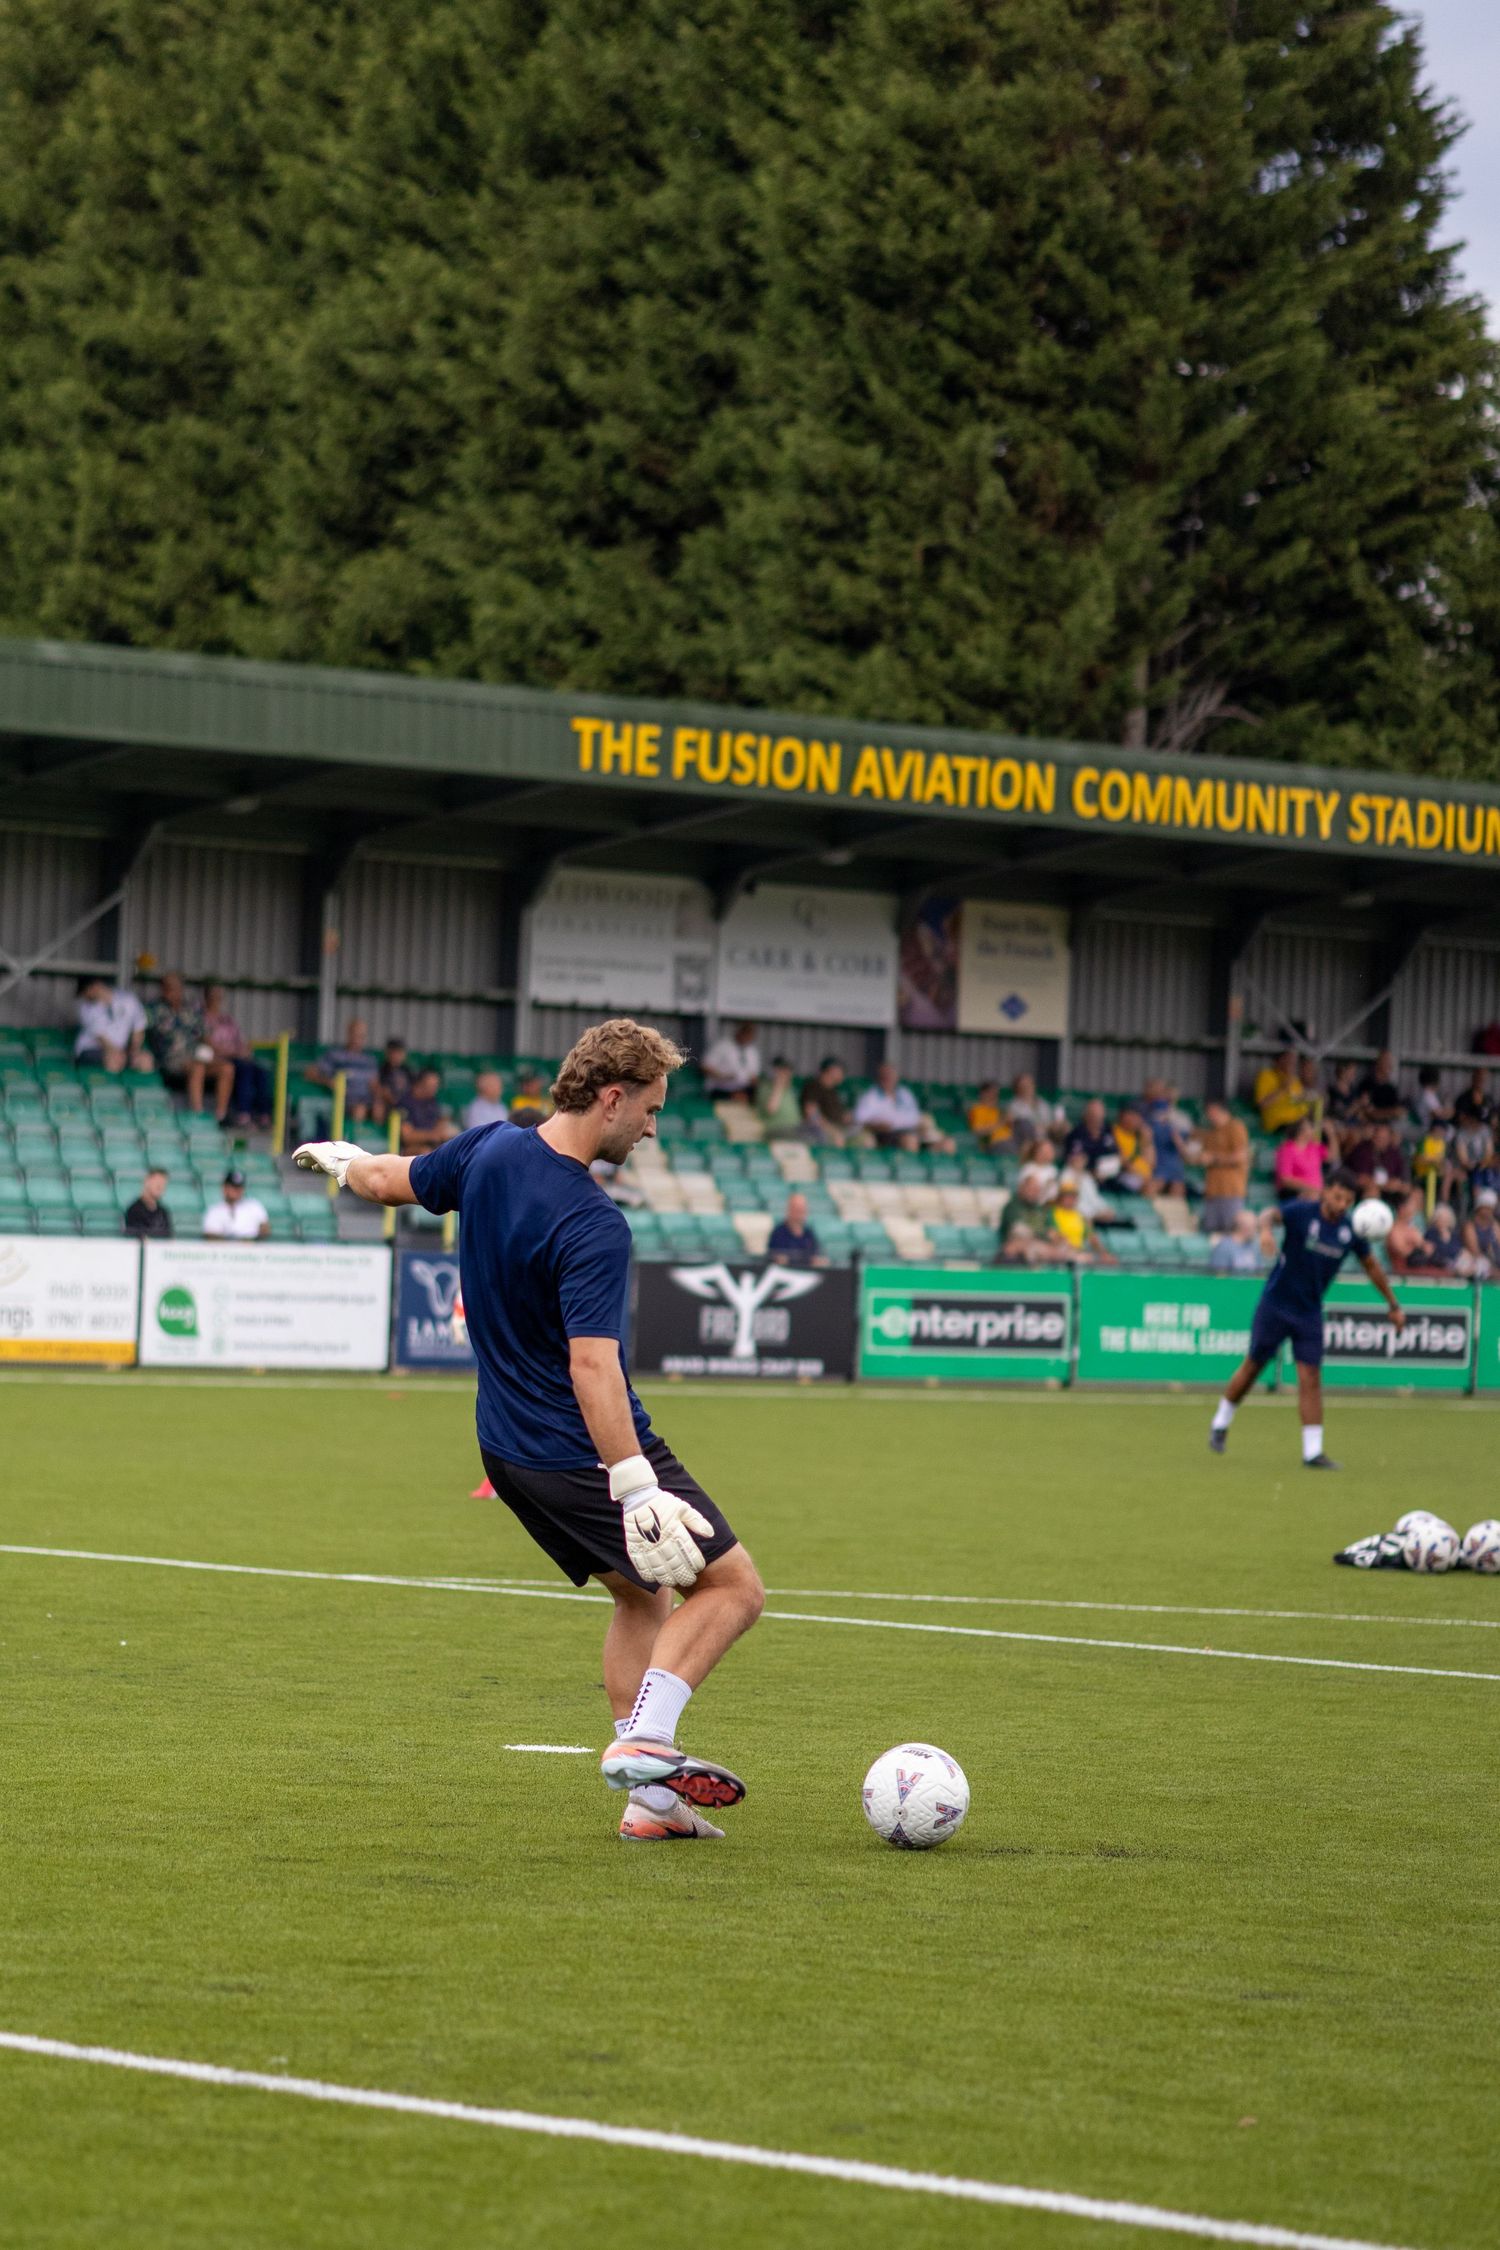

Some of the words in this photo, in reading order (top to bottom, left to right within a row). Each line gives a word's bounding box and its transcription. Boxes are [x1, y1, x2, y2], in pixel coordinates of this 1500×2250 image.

[571, 717, 662, 778] THE
[672, 726, 842, 795] FUSION
[850, 745, 1057, 814] AVIATION
[1072, 766, 1340, 841] COMMUNITY
[871, 1304, 1065, 1348] enterprise
[1323, 1316, 1466, 1357] nterprise
